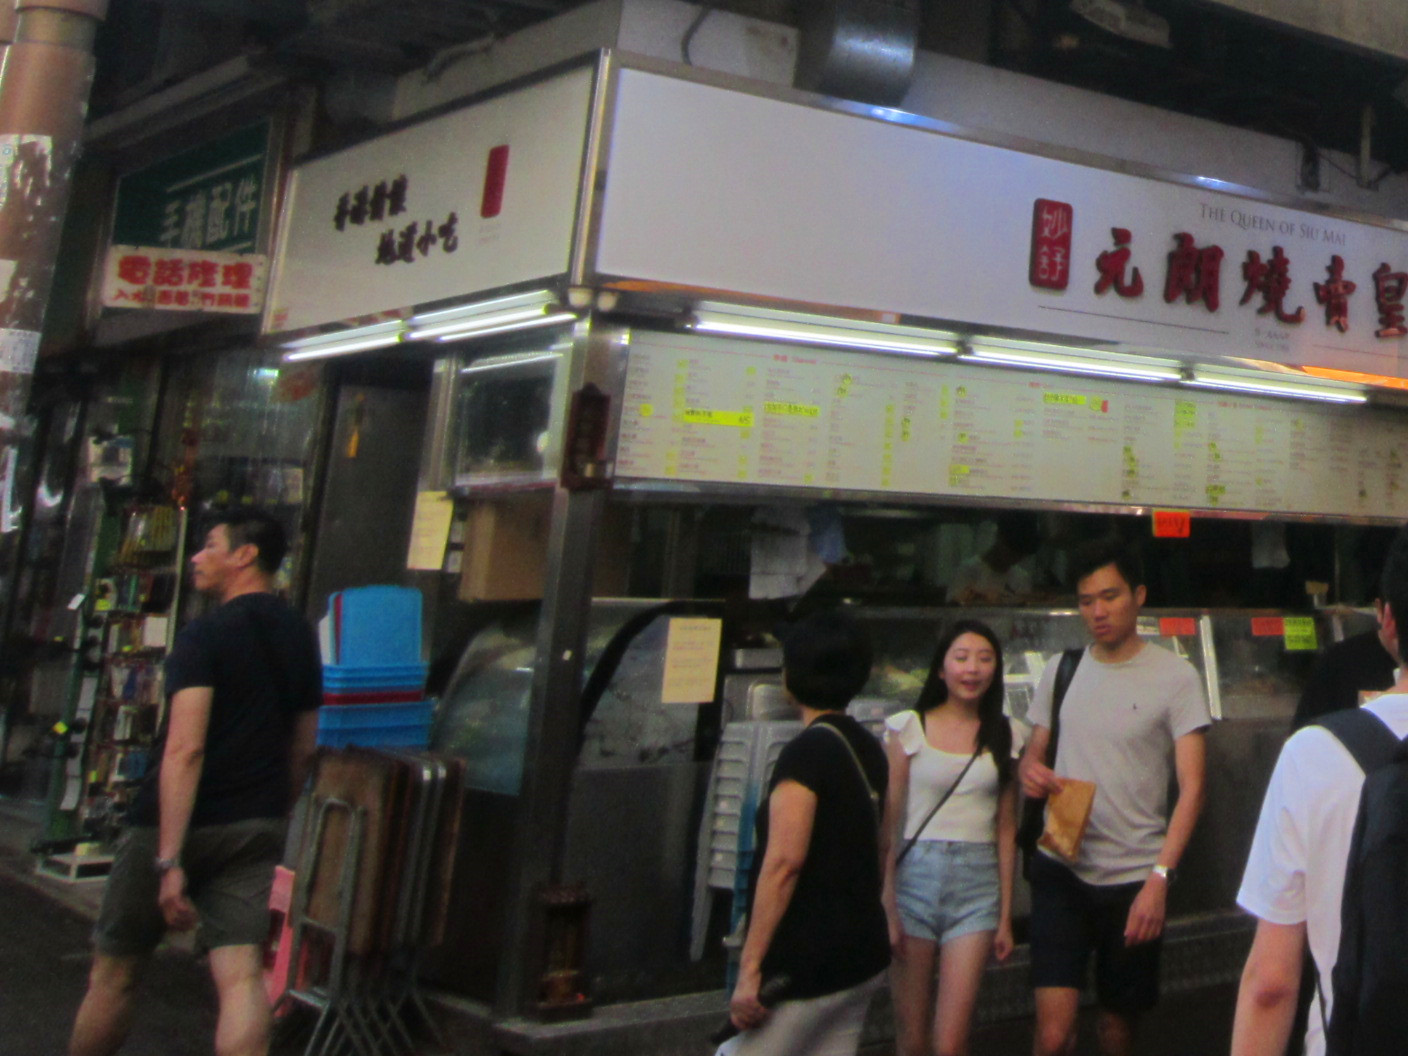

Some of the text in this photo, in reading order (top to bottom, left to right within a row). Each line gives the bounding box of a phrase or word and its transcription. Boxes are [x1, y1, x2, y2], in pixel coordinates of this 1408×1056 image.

[1041, 204, 1067, 282] 妙舒
[1201, 203, 1346, 246] THE QUEEN OF SIU MAI
